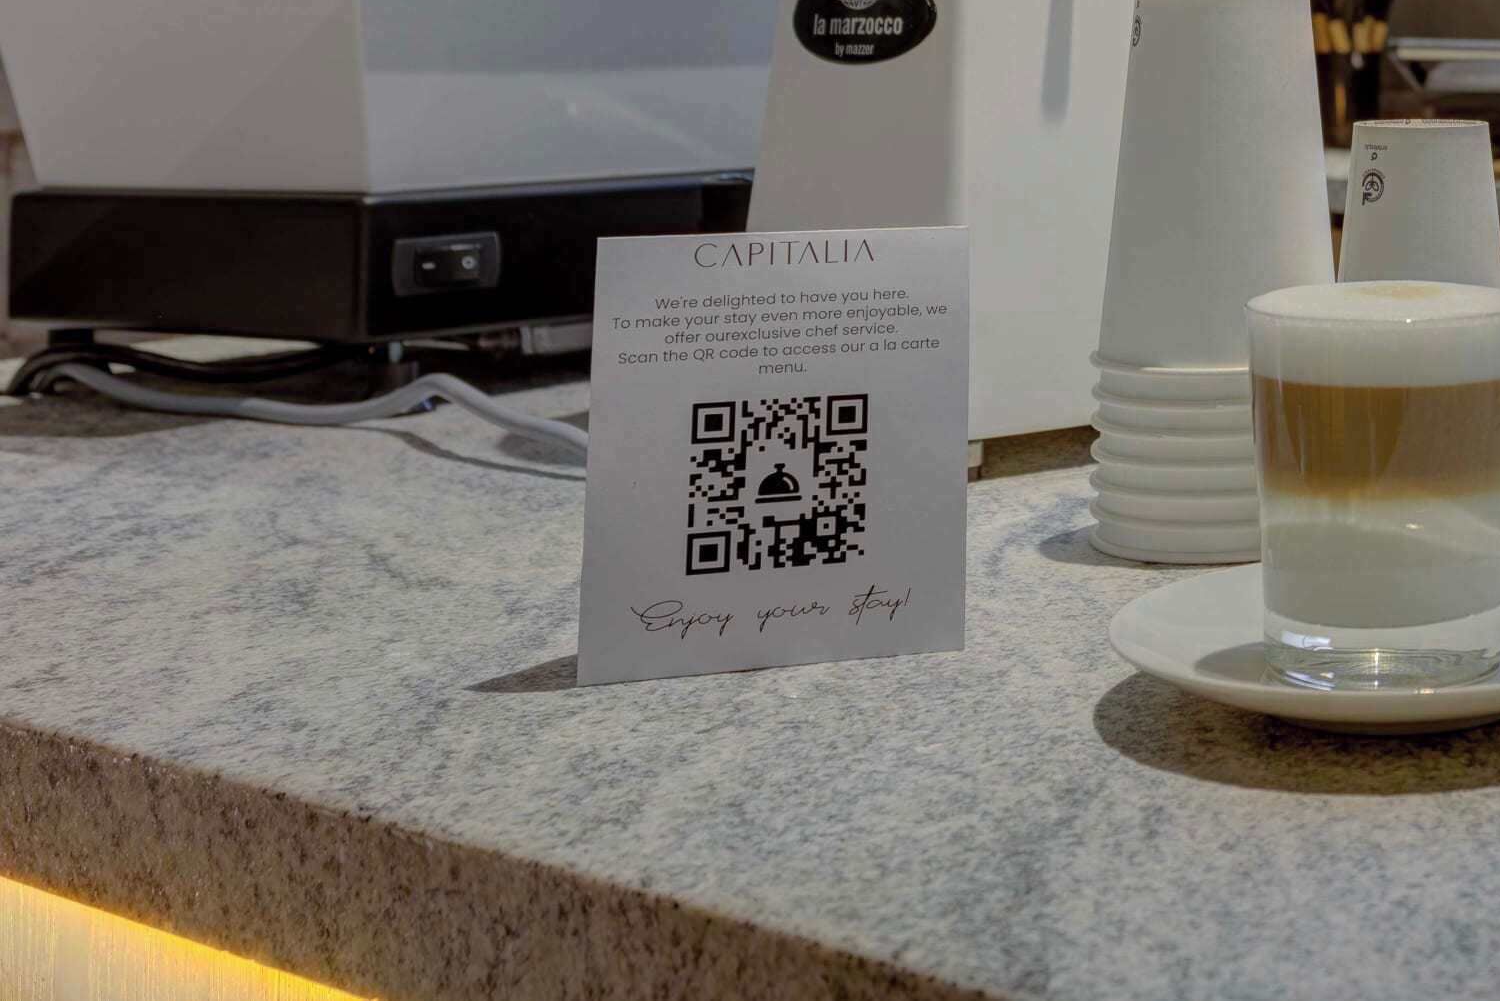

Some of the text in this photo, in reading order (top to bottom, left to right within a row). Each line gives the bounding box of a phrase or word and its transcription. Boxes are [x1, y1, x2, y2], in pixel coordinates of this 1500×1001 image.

[813, 14, 903, 36] la marzocco
[835, 41, 844, 57] by
[694, 238, 875, 268] CAPITALIA
[655, 287, 909, 311] We're delighted to have you here.
[612, 303, 948, 331] To make your stay even more enjoyable, we
[664, 322, 898, 345] offer ourexclusive chef service.
[618, 335, 940, 365] Scan the QR code to access our a la carte
[758, 362, 808, 375] menu.
[630, 599, 733, 639] Enjoy
[756, 601, 832, 632] your
